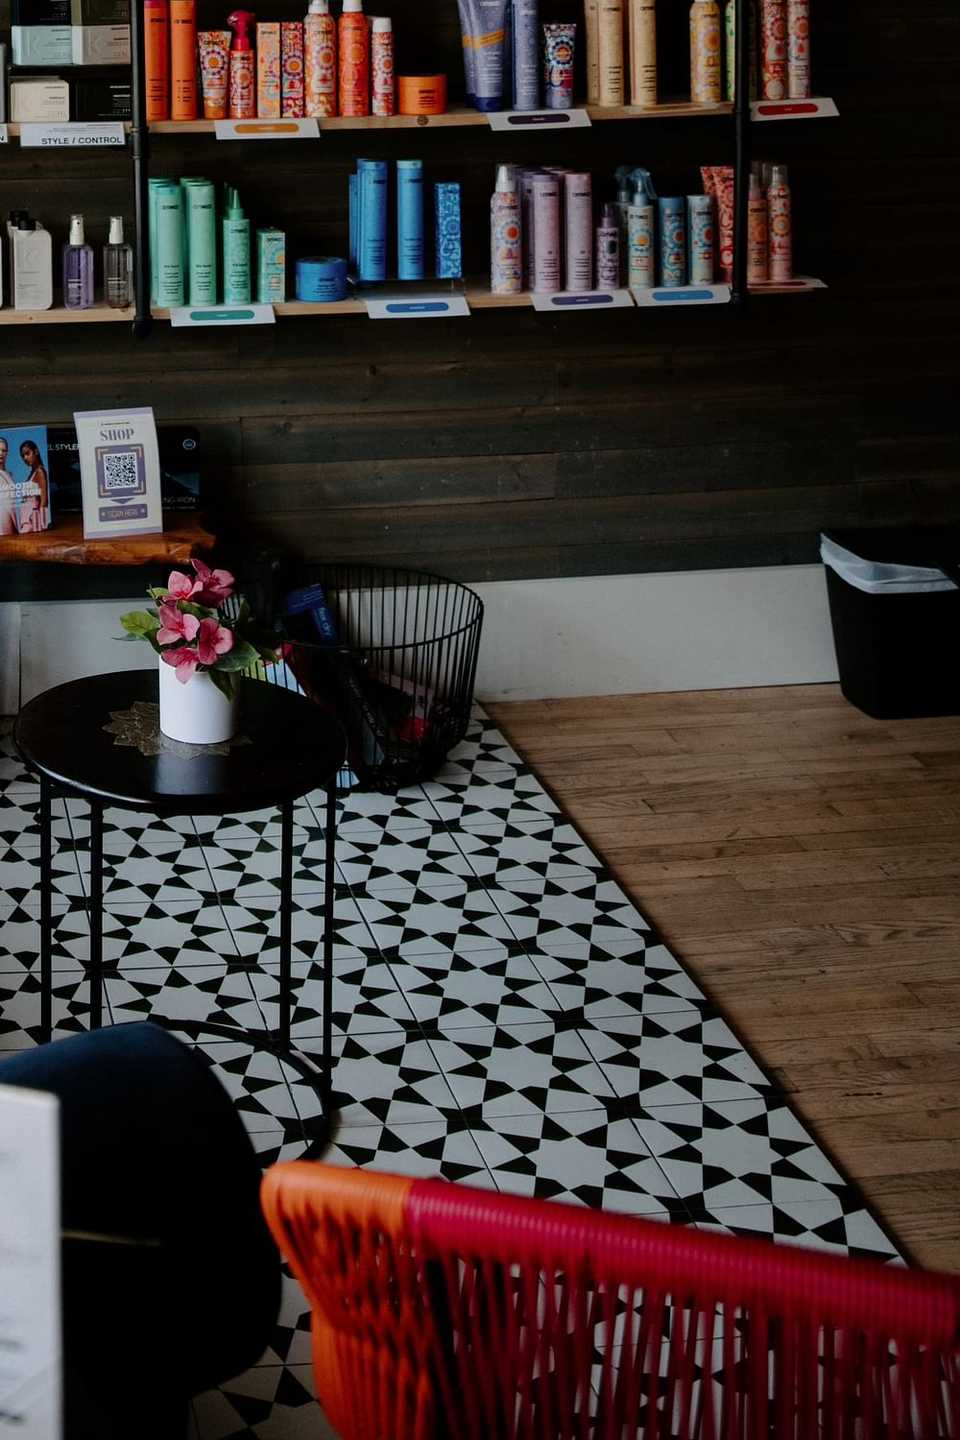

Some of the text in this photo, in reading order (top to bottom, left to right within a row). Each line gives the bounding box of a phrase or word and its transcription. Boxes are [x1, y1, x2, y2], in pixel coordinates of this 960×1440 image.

[41, 137, 69, 145] STYLE
[78, 136, 122, 144] CONTROL
[100, 427, 135, 441] SHOP
